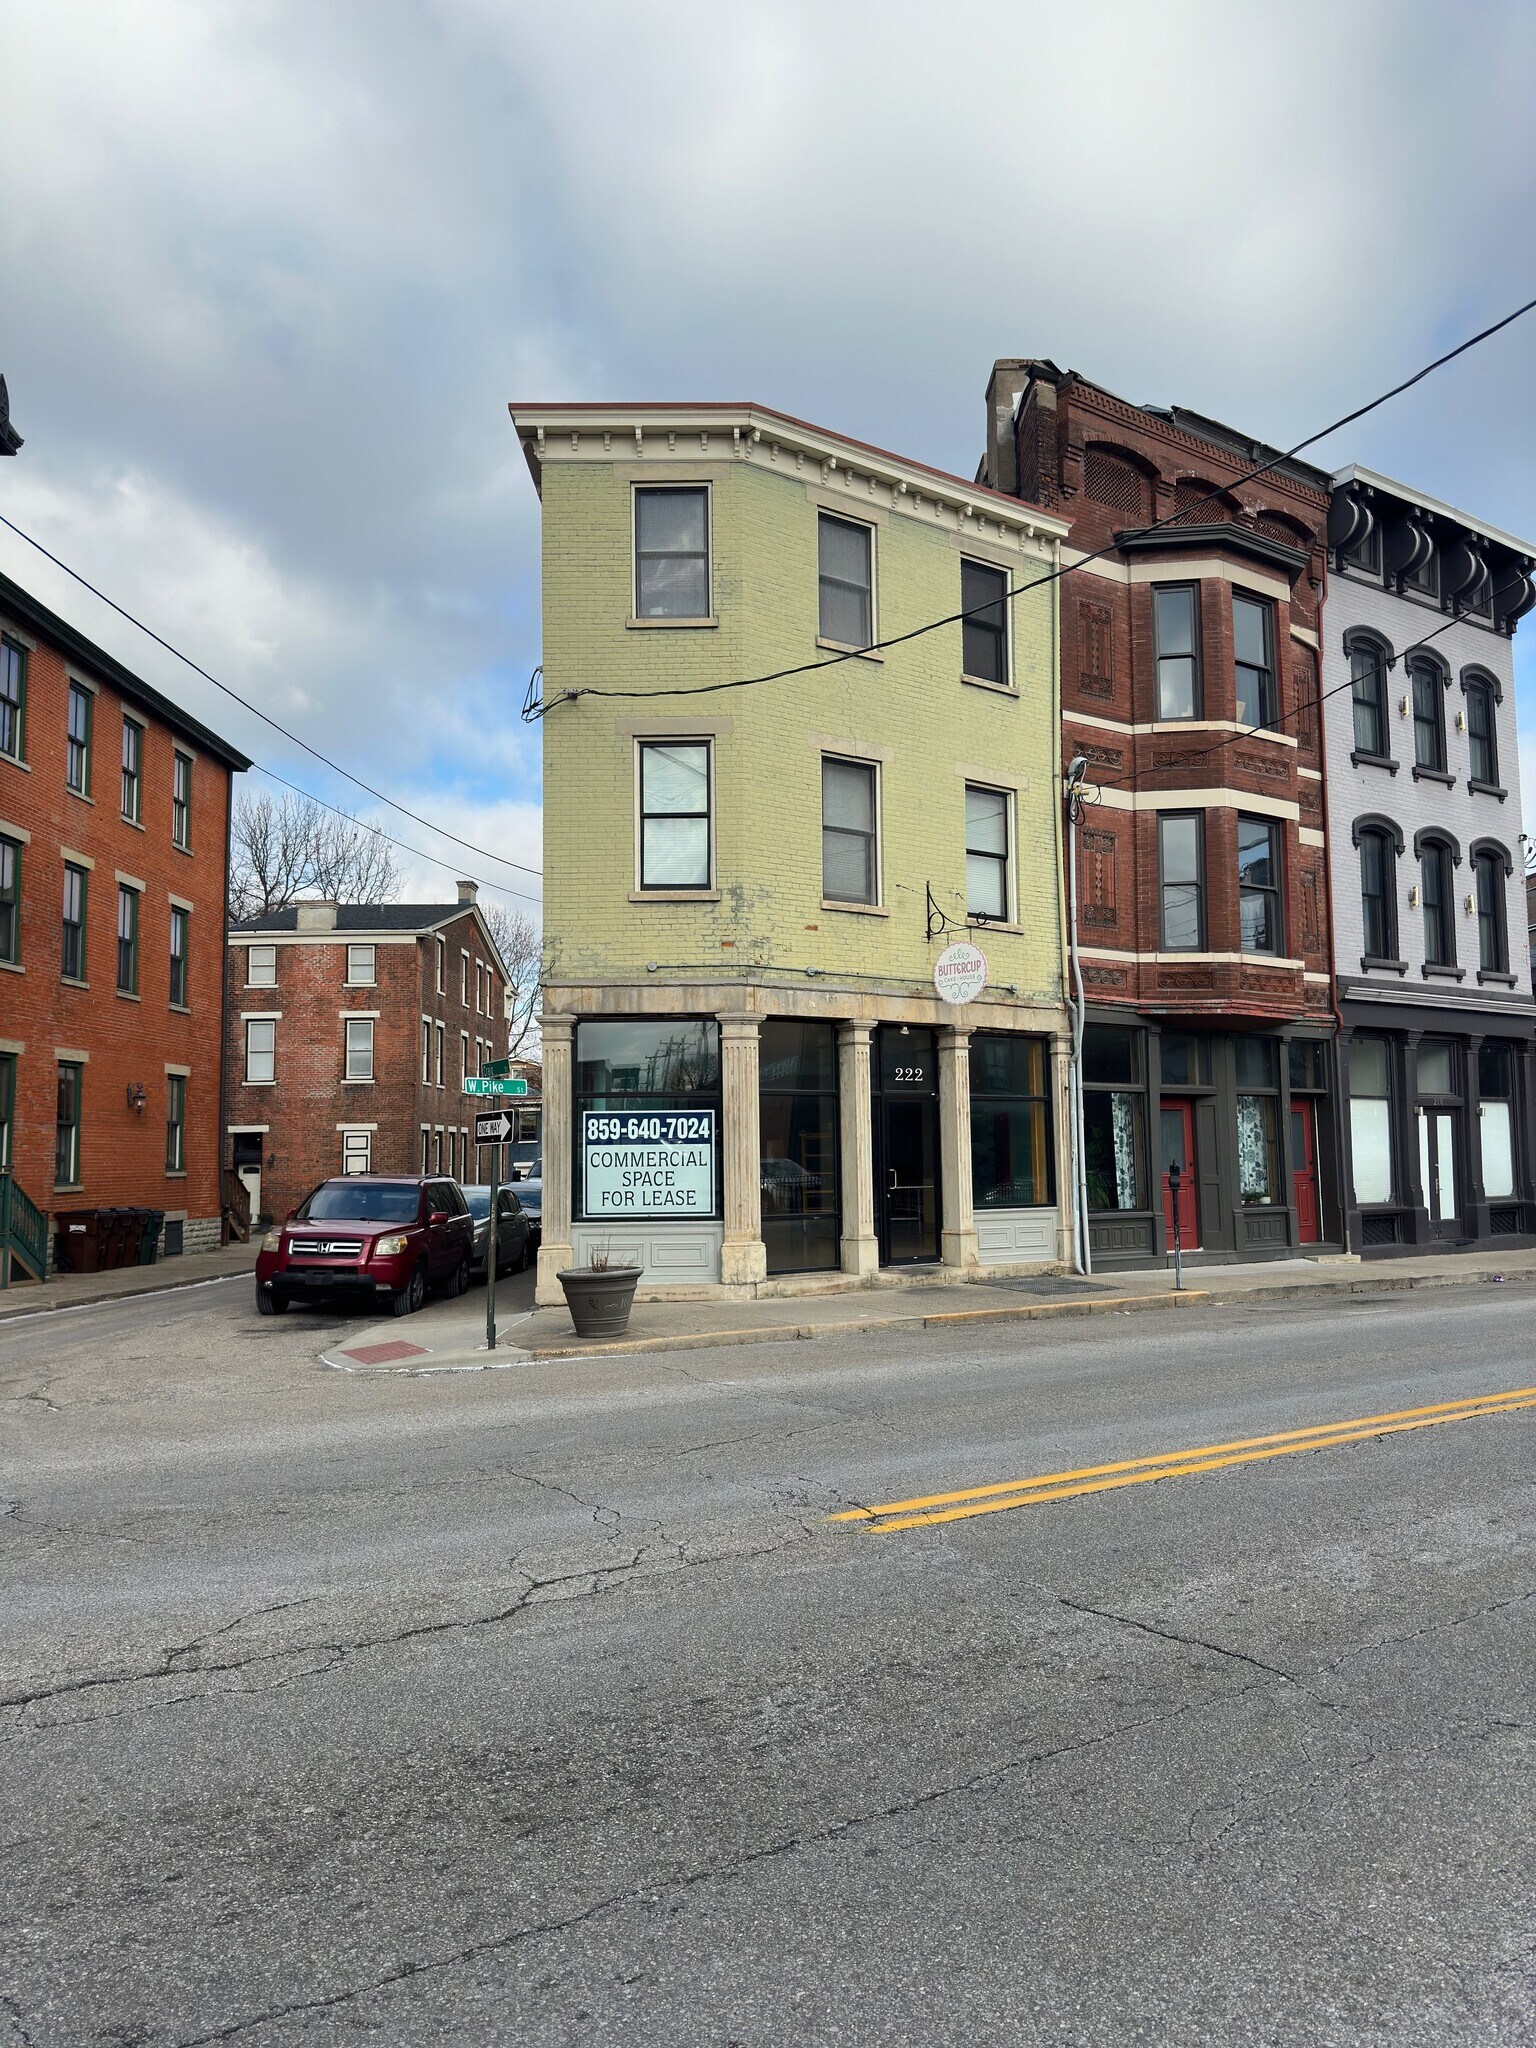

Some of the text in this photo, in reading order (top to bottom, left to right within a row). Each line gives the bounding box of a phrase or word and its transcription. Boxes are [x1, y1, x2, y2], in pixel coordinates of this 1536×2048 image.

[938, 960, 981, 976] BUTTERCUP
[895, 1067, 923, 1081] 222
[468, 1080, 480, 1092] W.
[482, 1080, 504, 1092] Pike
[479, 1120, 501, 1135] ONE WAY
[587, 1118, 710, 1140] 859-640-7024
[590, 1151, 707, 1167] COMMERCIAL
[622, 1171, 675, 1187] SPACE
[602, 1190, 696, 1206] FOR LEASE
